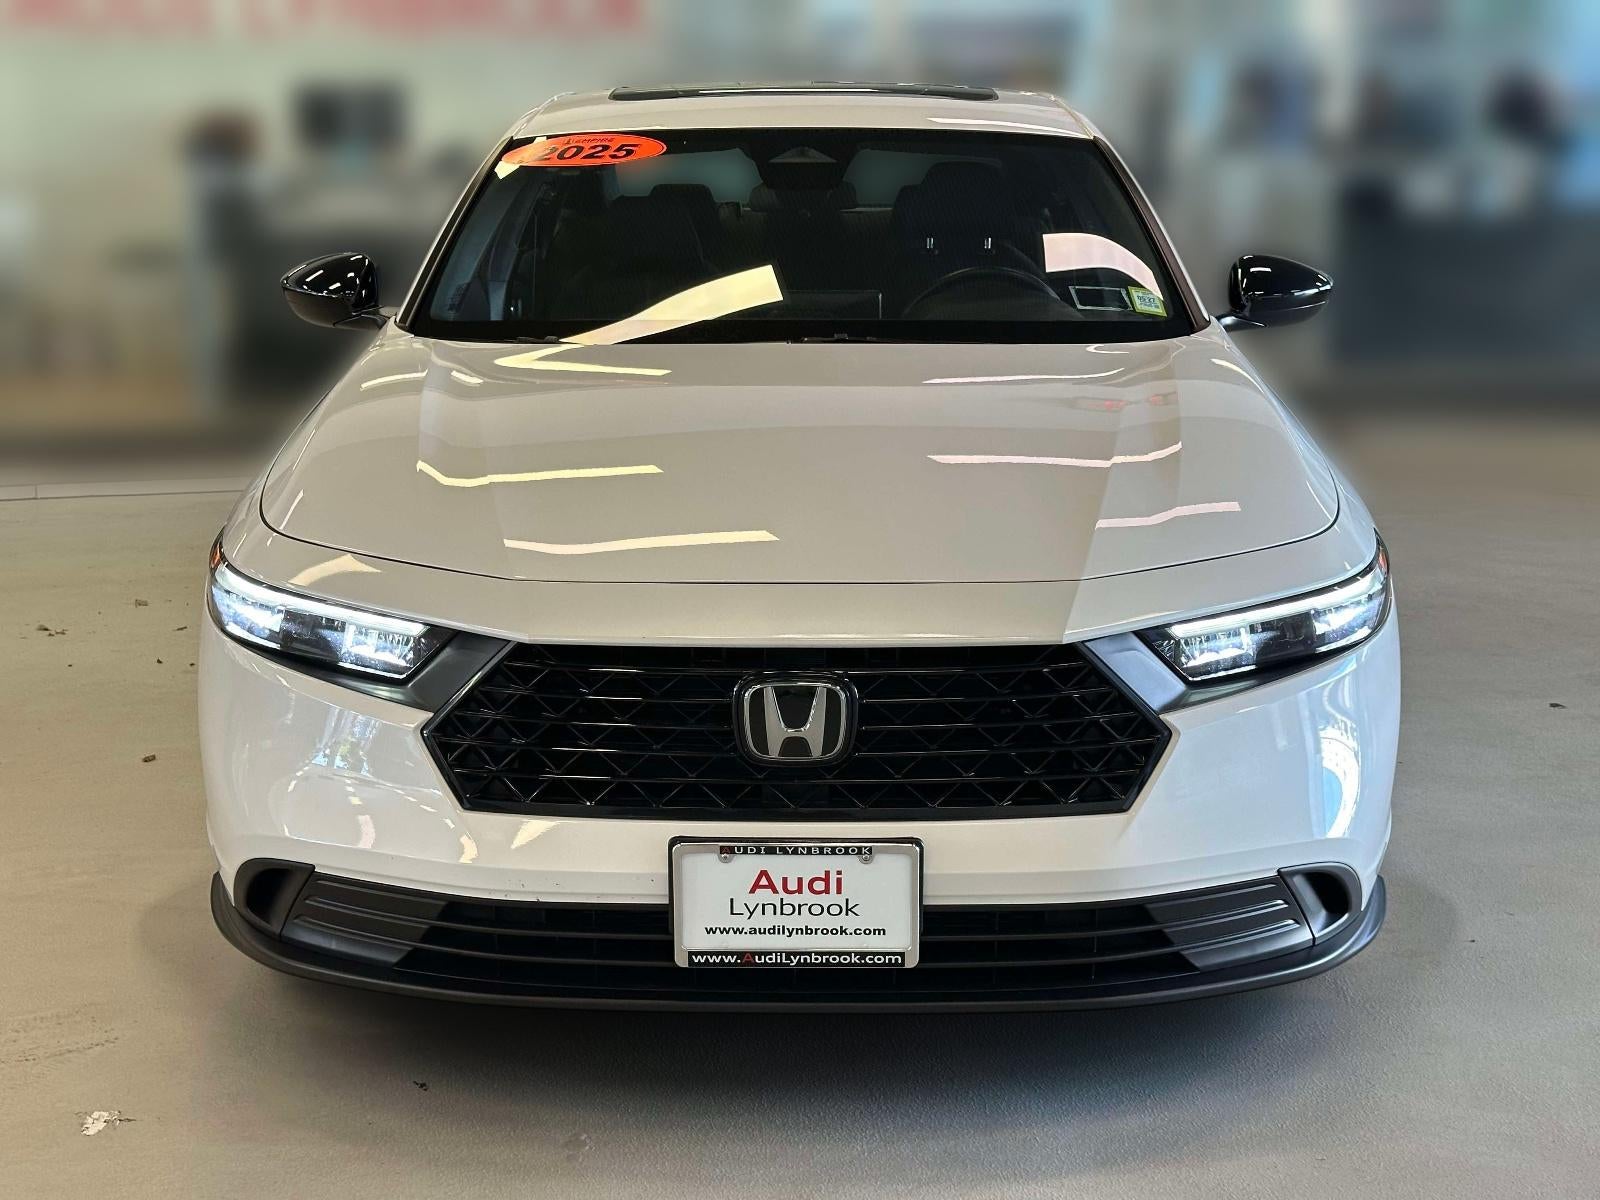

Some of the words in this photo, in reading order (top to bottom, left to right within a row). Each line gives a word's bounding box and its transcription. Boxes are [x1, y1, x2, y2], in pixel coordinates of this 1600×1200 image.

[538, 143, 642, 161] 2025
[721, 846, 766, 855] AUDI
[776, 846, 871, 855] LYNBROOK
[748, 869, 843, 895] Audi
[729, 898, 860, 920] Lynbrook
[704, 925, 887, 938] www.audilynbrook.com
[691, 952, 902, 966] www.AudiLynbrook.com
